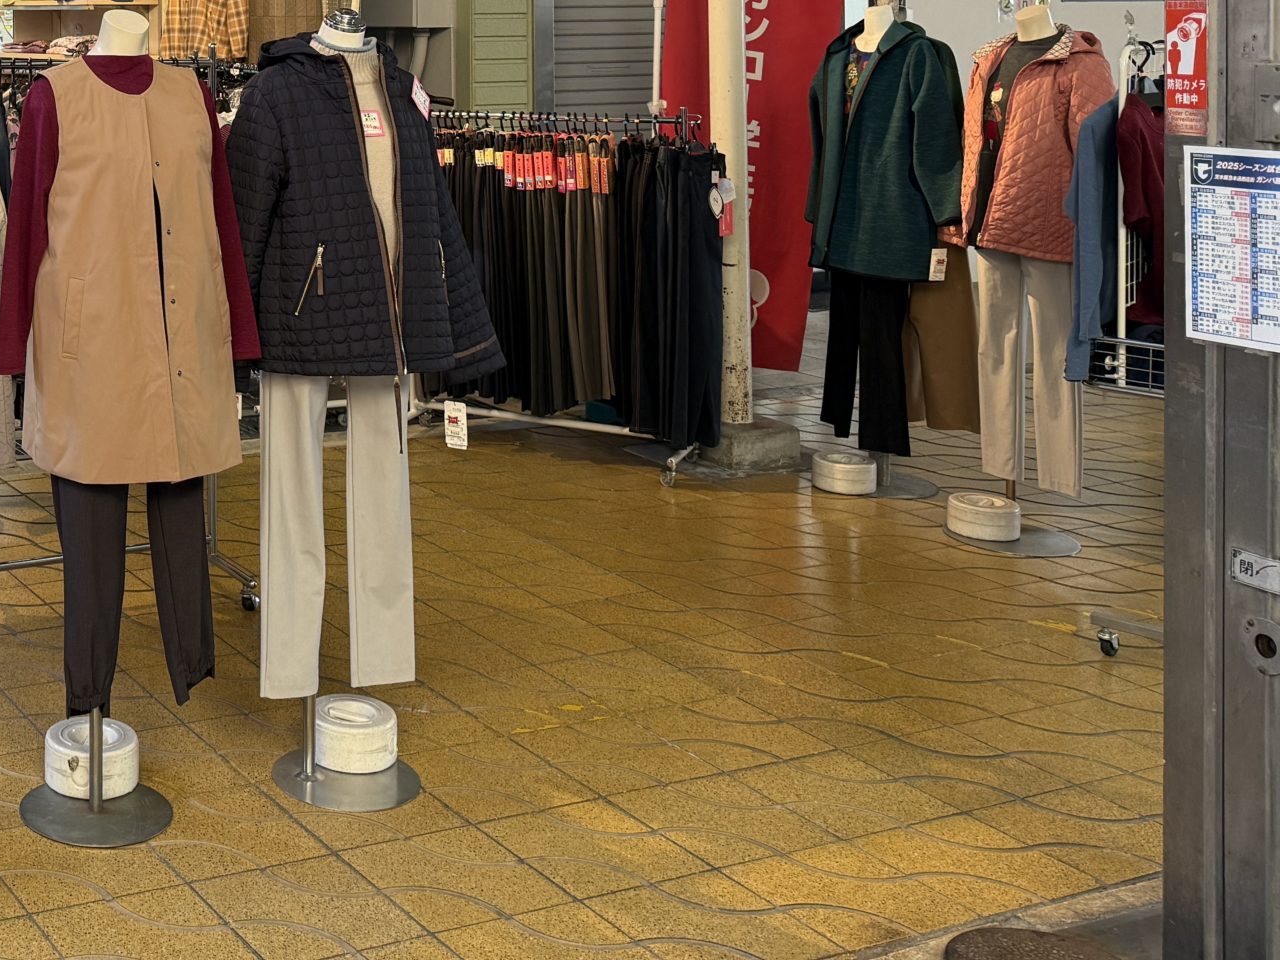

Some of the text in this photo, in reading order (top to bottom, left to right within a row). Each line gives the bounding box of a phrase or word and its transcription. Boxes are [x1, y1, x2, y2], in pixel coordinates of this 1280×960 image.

[1167, 79, 1206, 91] 防犯カメラ
[1175, 93, 1199, 105] 作動中
[1239, 559, 1254, 577] 閉
